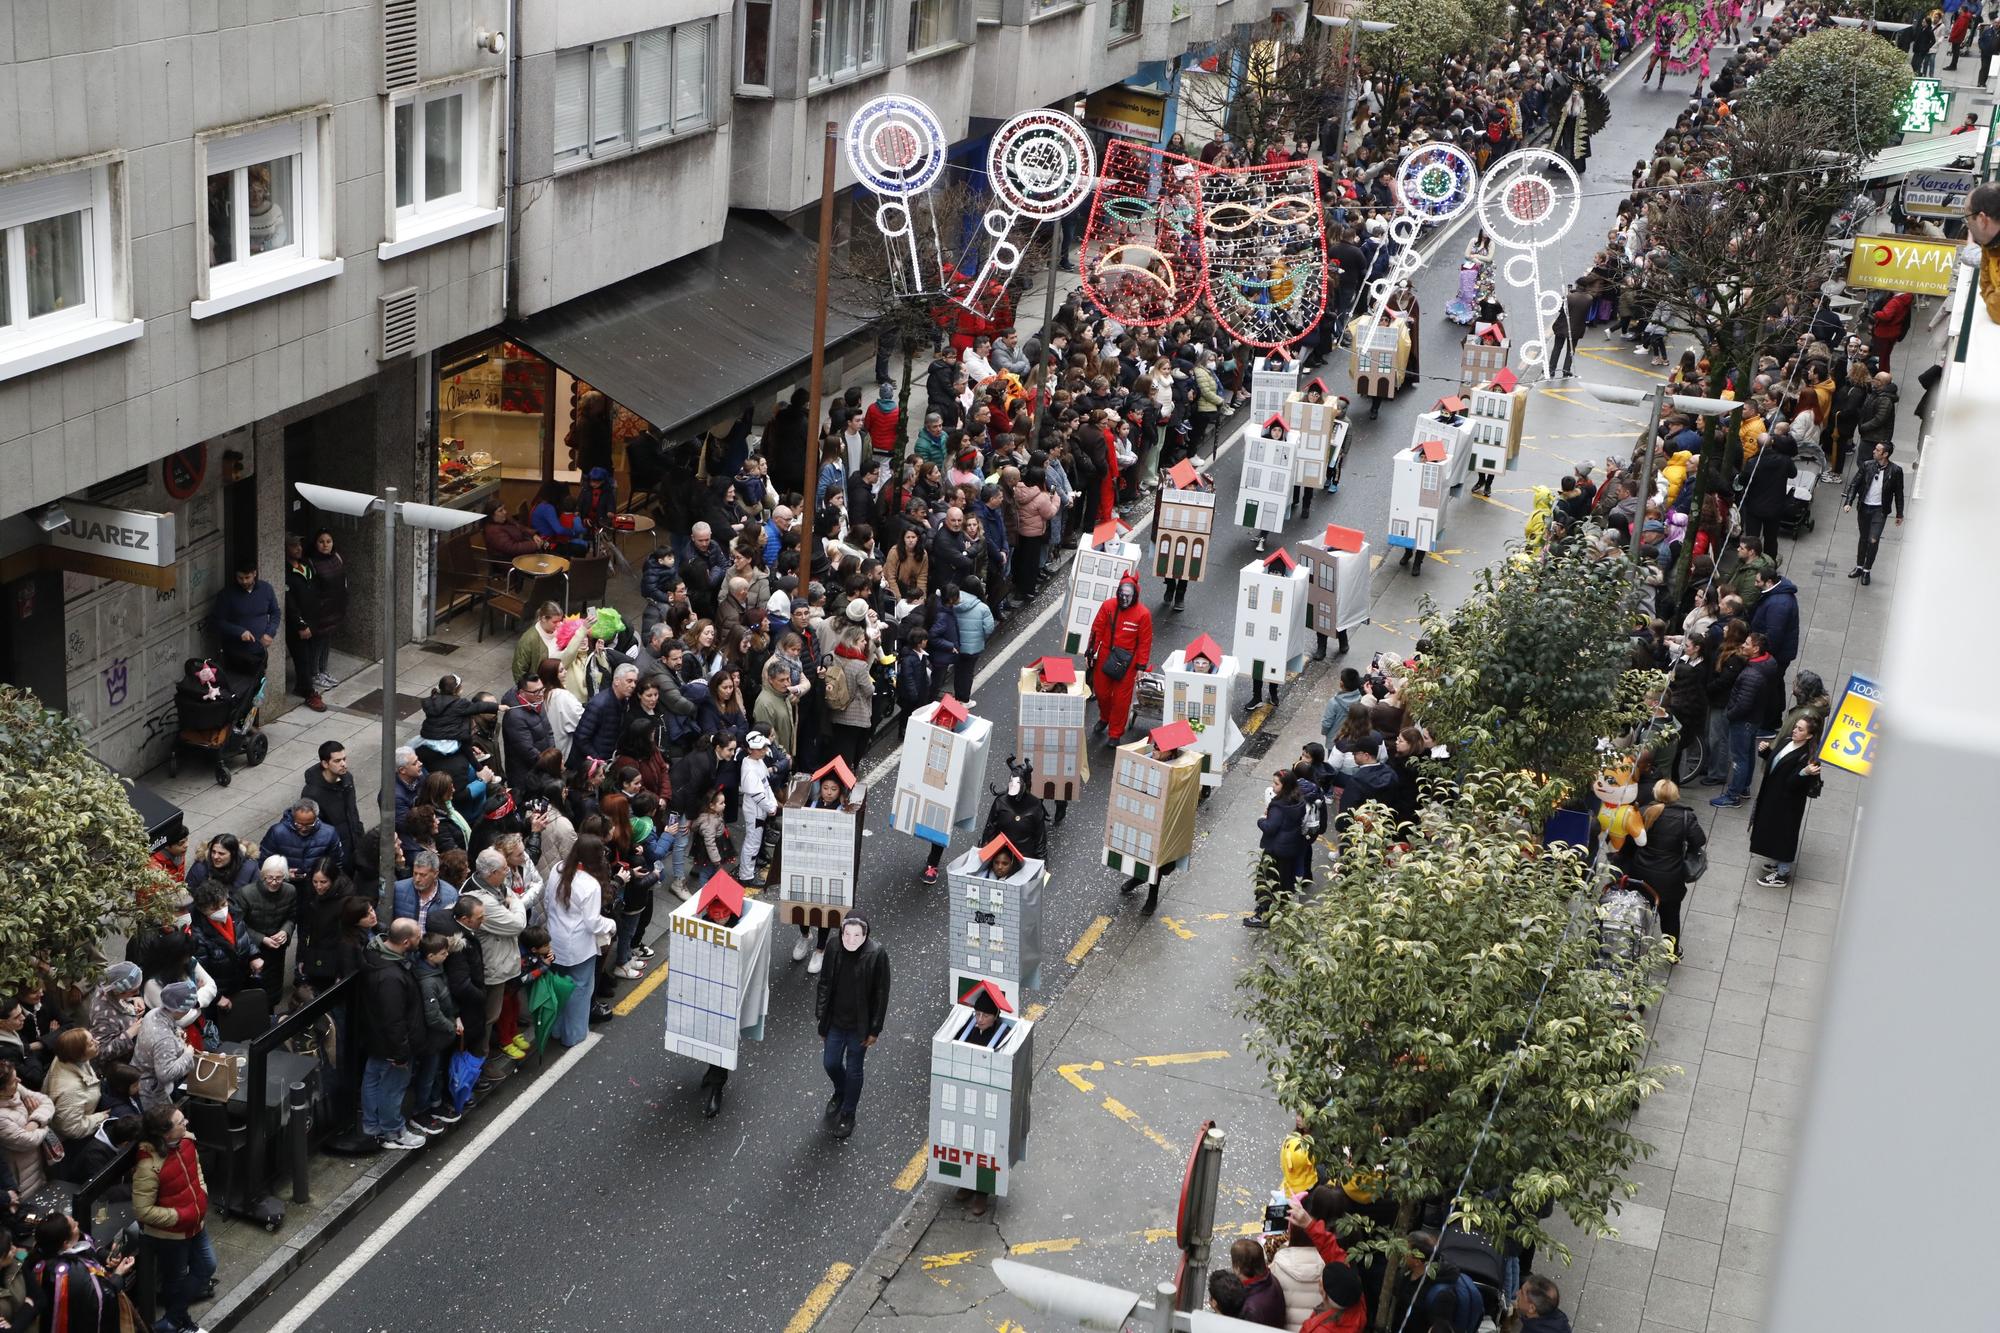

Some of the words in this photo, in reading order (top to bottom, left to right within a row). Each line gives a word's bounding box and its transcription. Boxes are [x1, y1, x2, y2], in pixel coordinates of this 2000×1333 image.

[1910, 174, 1971, 192] Karaoke
[1859, 243, 1957, 273] TOYAMA
[1858, 274, 1914, 286] RESTAURANTE
[1842, 714, 1861, 728] The
[673, 915, 738, 951] HOTEL
[933, 1144, 1001, 1172] HOTEL
